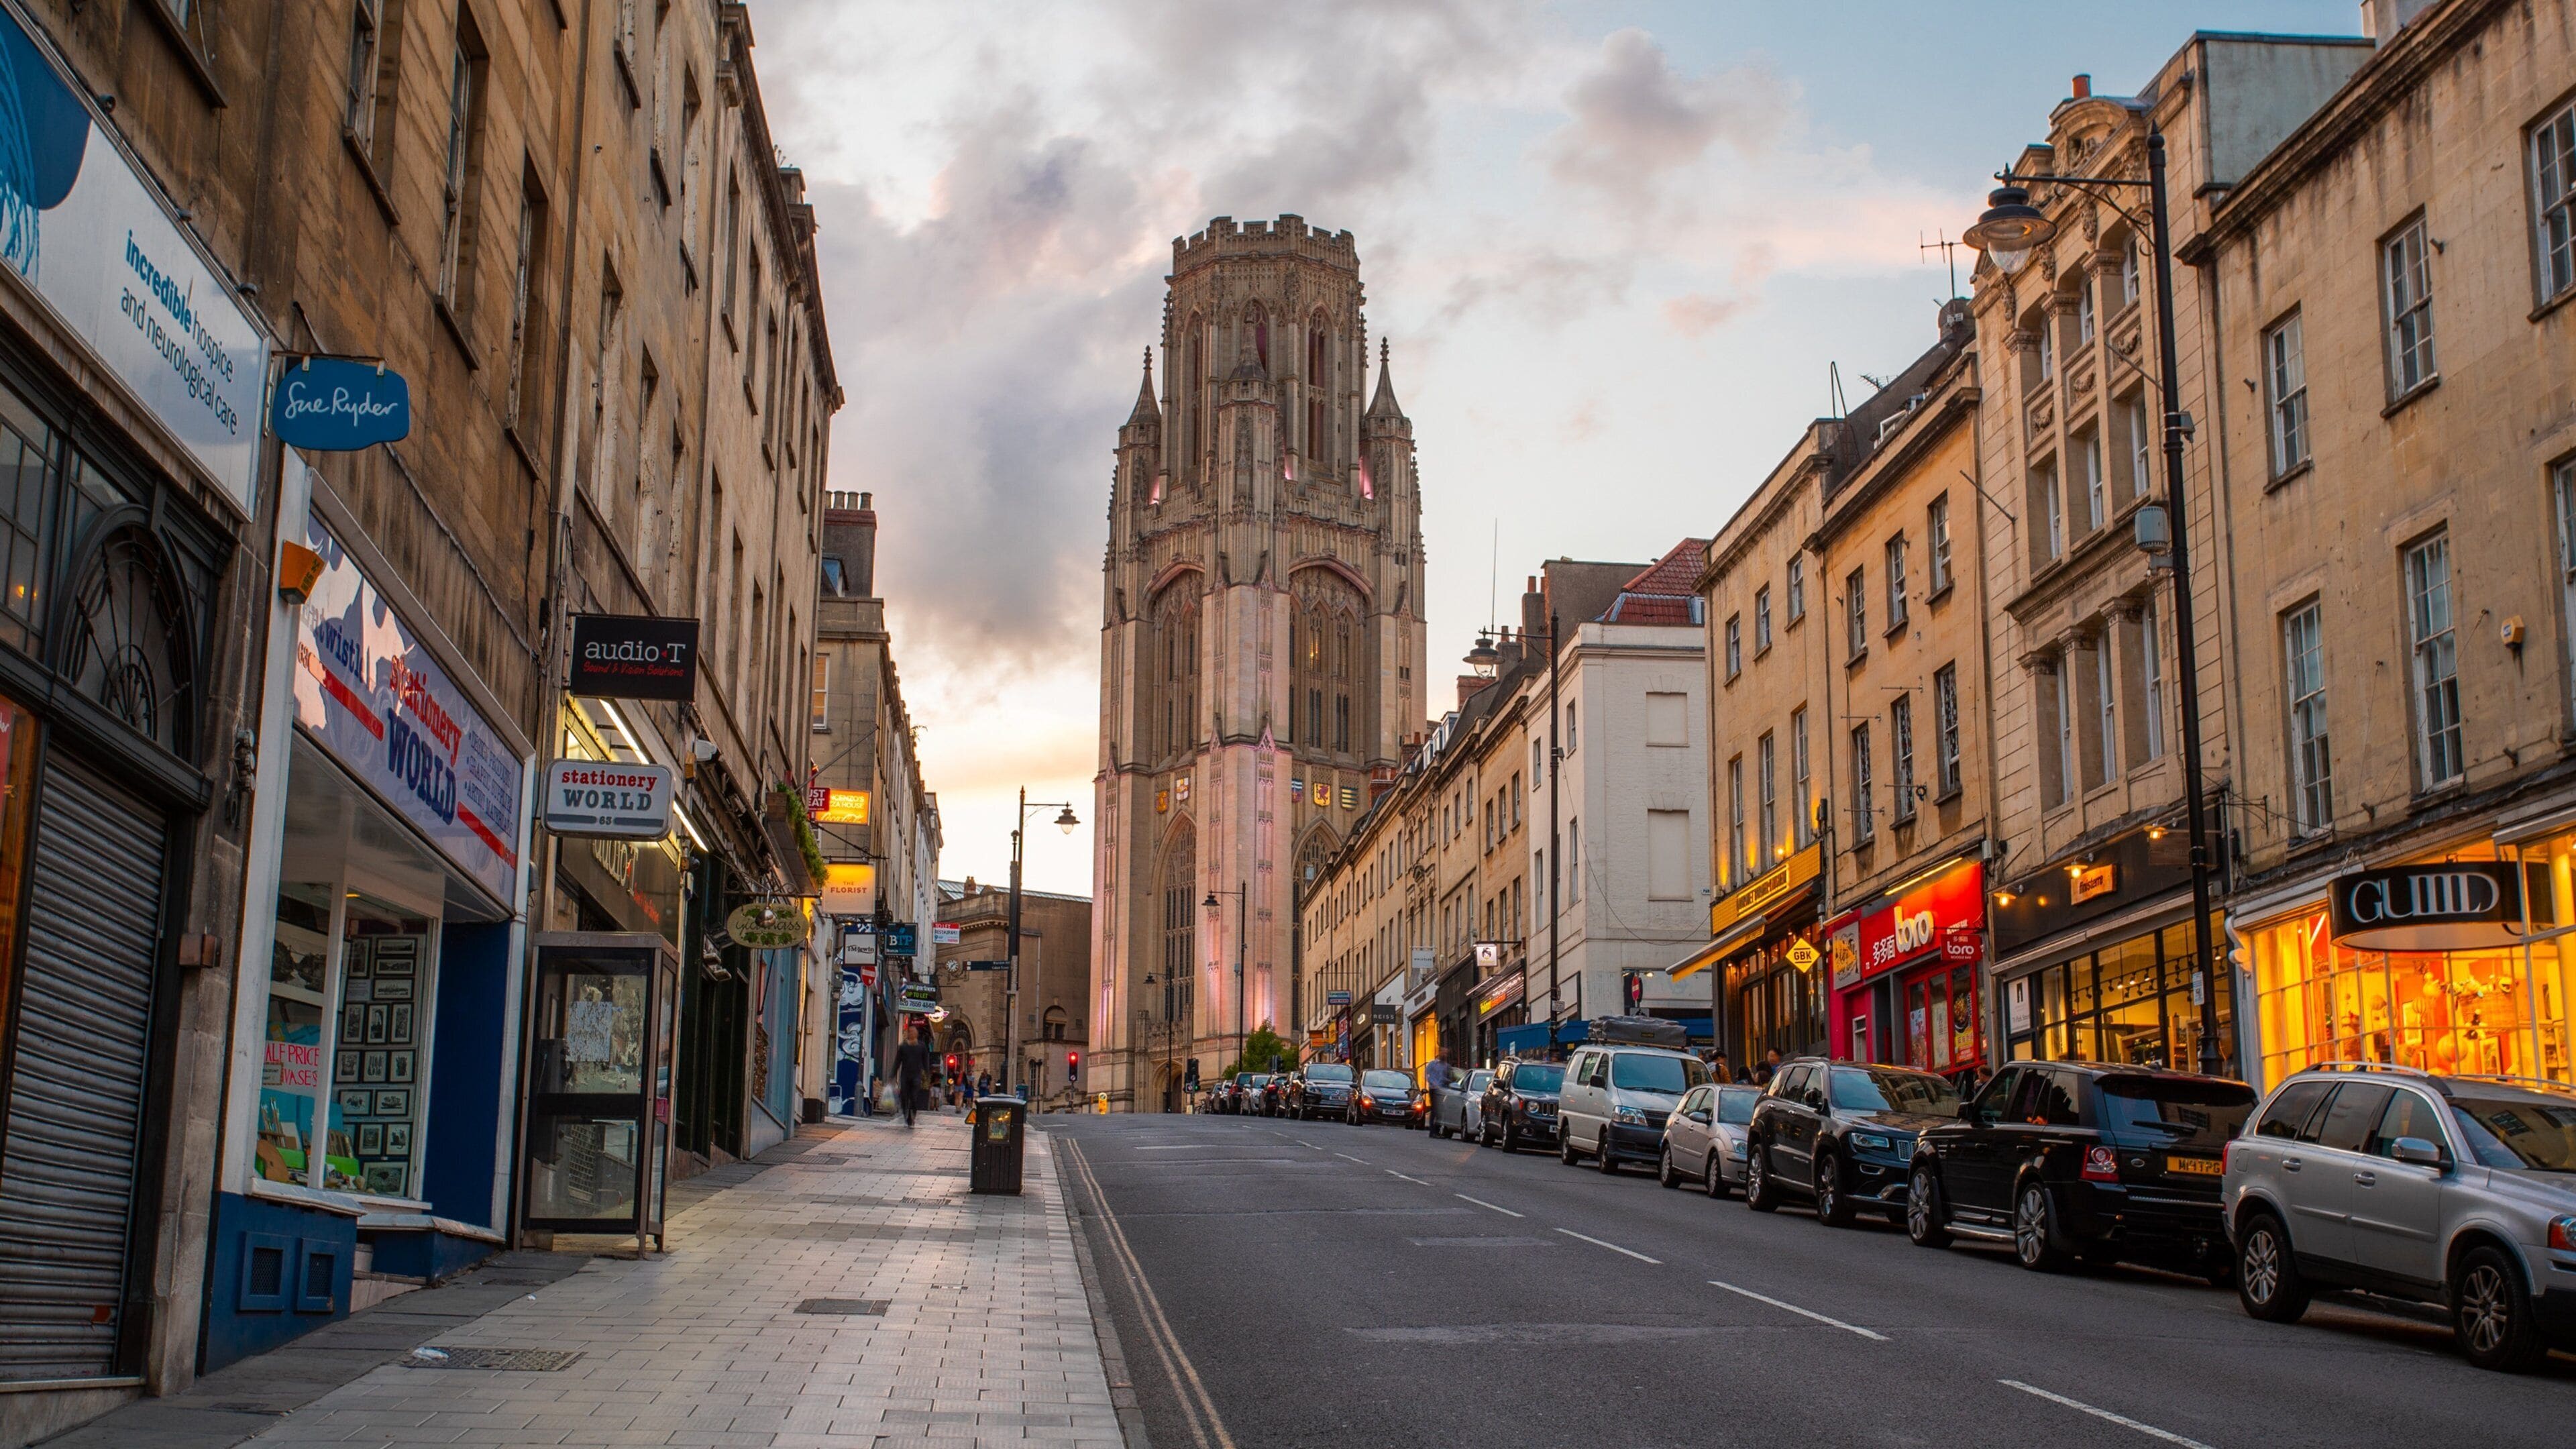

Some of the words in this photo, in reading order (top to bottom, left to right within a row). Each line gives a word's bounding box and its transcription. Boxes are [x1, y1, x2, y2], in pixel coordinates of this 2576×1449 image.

[125, 229, 191, 333] incredible
[193, 311, 233, 383] hospice
[121, 286, 146, 331] and
[146, 315, 215, 411] neurological
[215, 394, 237, 435] care
[285, 382, 329, 419] Sue
[331, 387, 398, 427] Ryder
[585, 641, 659, 662] audio
[667, 643, 686, 663] T
[583, 659, 611, 674] Sound
[621, 663, 645, 675] Vision
[647, 663, 685, 678] Solutions
[389, 654, 462, 767] stationery
[387, 707, 456, 826] WORLD
[561, 769, 657, 792] stationery
[564, 788, 652, 811] WORLD
[598, 815, 612, 826] 63
[2080, 875, 2104, 895] finisterre
[889, 934, 913, 946] BTP
[1894, 906, 1934, 953] toro
[1794, 951, 1812, 960] GBK
[1947, 941, 1974, 955] toro
[266, 1042, 286, 1062] ALF
[288, 1044, 320, 1067] PRICE
[283, 1068, 318, 1087] VASES
